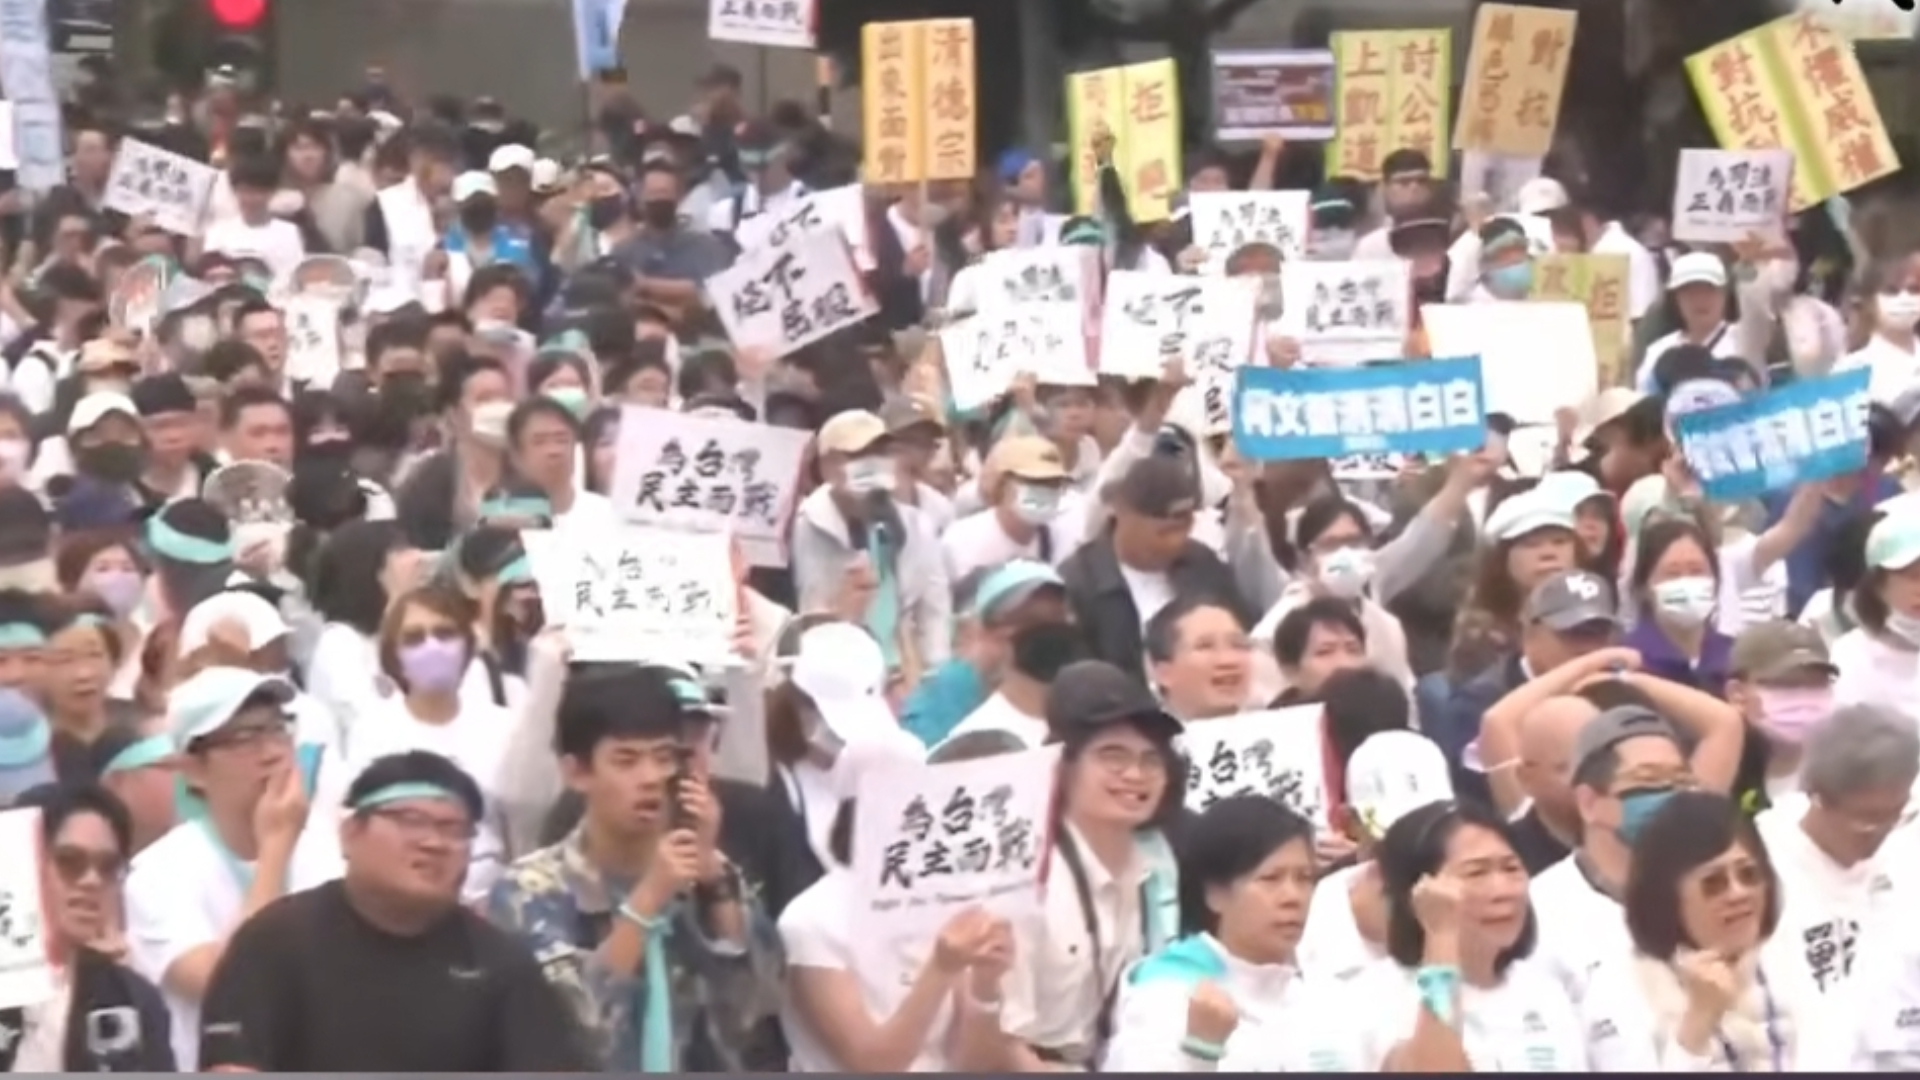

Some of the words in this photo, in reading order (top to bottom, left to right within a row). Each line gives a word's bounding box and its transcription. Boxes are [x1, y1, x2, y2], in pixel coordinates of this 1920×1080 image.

[932, 24, 969, 175] 清德宗
[635, 471, 778, 526] 民主而戰
[900, 785, 1014, 841] 為台灣
[879, 836, 1035, 889] 民主而戰
